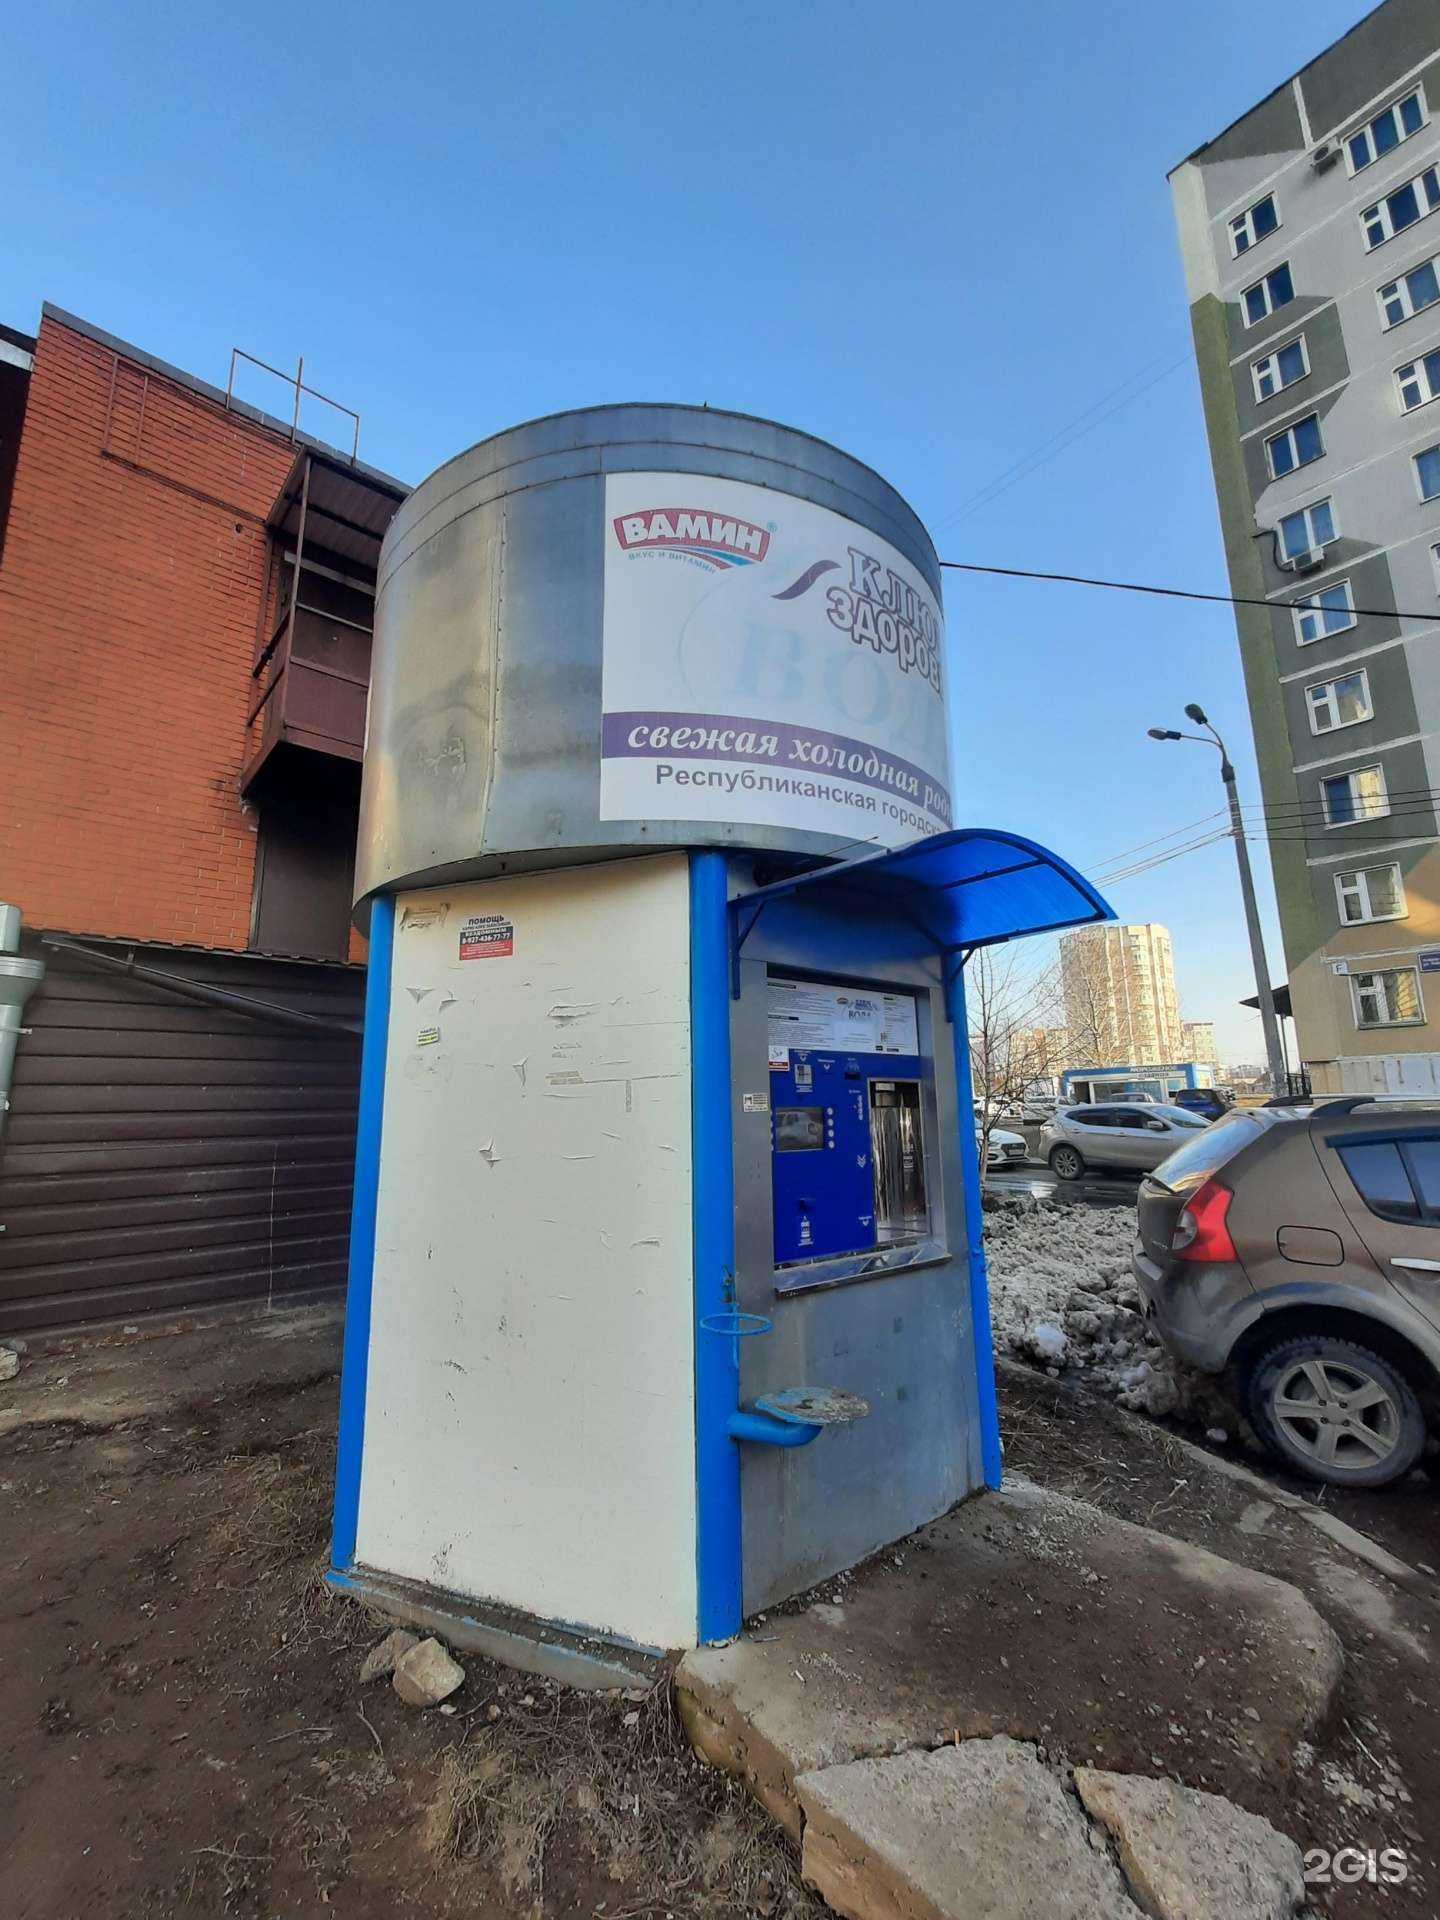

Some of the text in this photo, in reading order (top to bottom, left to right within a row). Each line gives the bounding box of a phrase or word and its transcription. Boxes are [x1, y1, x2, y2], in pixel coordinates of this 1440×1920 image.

[622, 513, 764, 555] ВАМИН
[627, 725, 779, 757] свежая
[787, 736, 919, 796] холодная
[655, 763, 876, 812] Республиканская
[468, 914, 504, 926] ПОМОЩЬ
